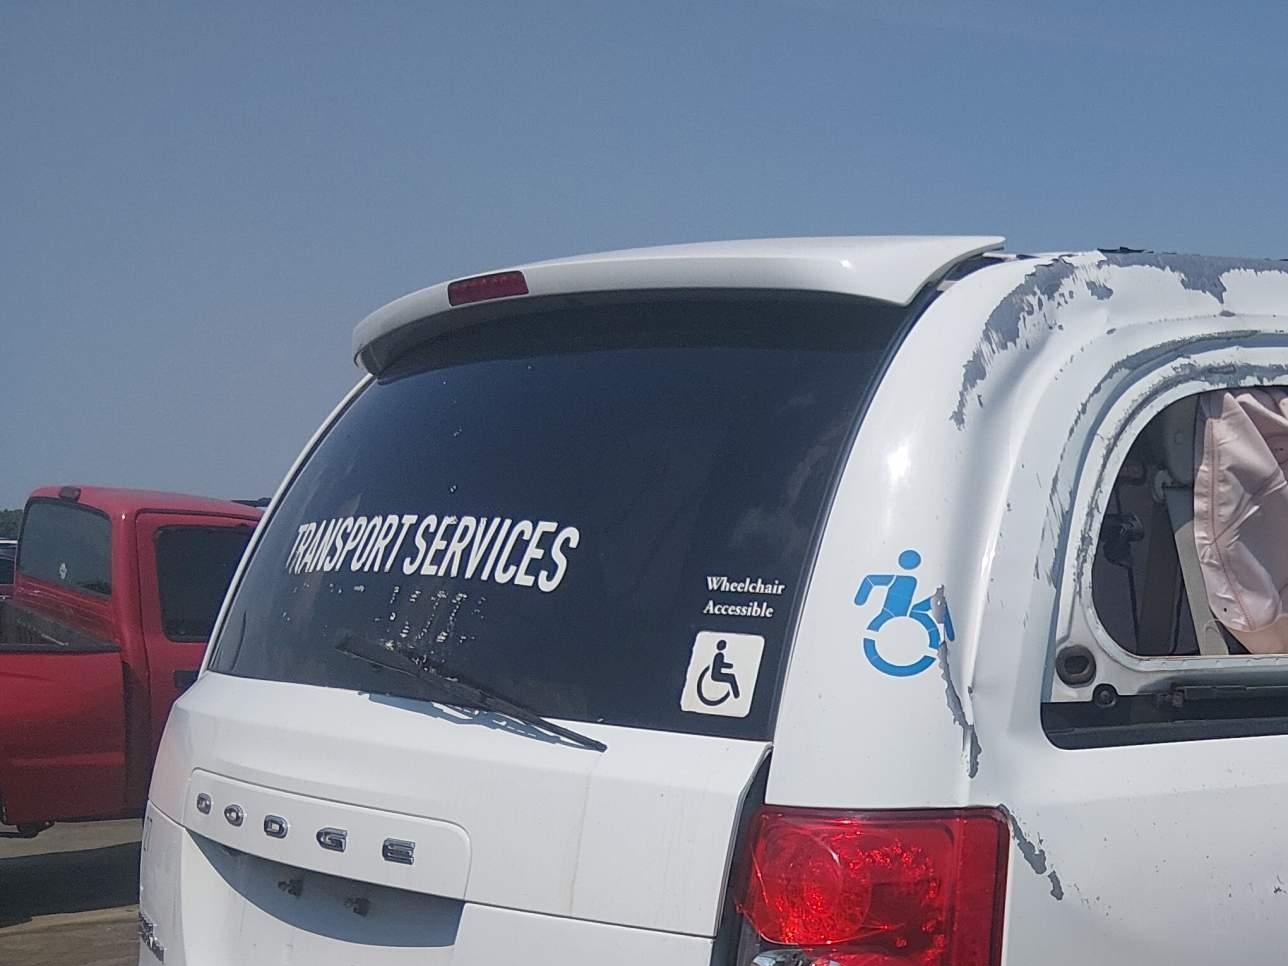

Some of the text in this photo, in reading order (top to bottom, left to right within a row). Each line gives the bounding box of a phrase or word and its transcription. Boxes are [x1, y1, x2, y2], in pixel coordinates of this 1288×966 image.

[286, 514, 580, 592] TRANSPORT SERVICES
[706, 575, 785, 595] Wheelchair
[703, 600, 774, 618] Accessible
[196, 792, 416, 866] DODGE
